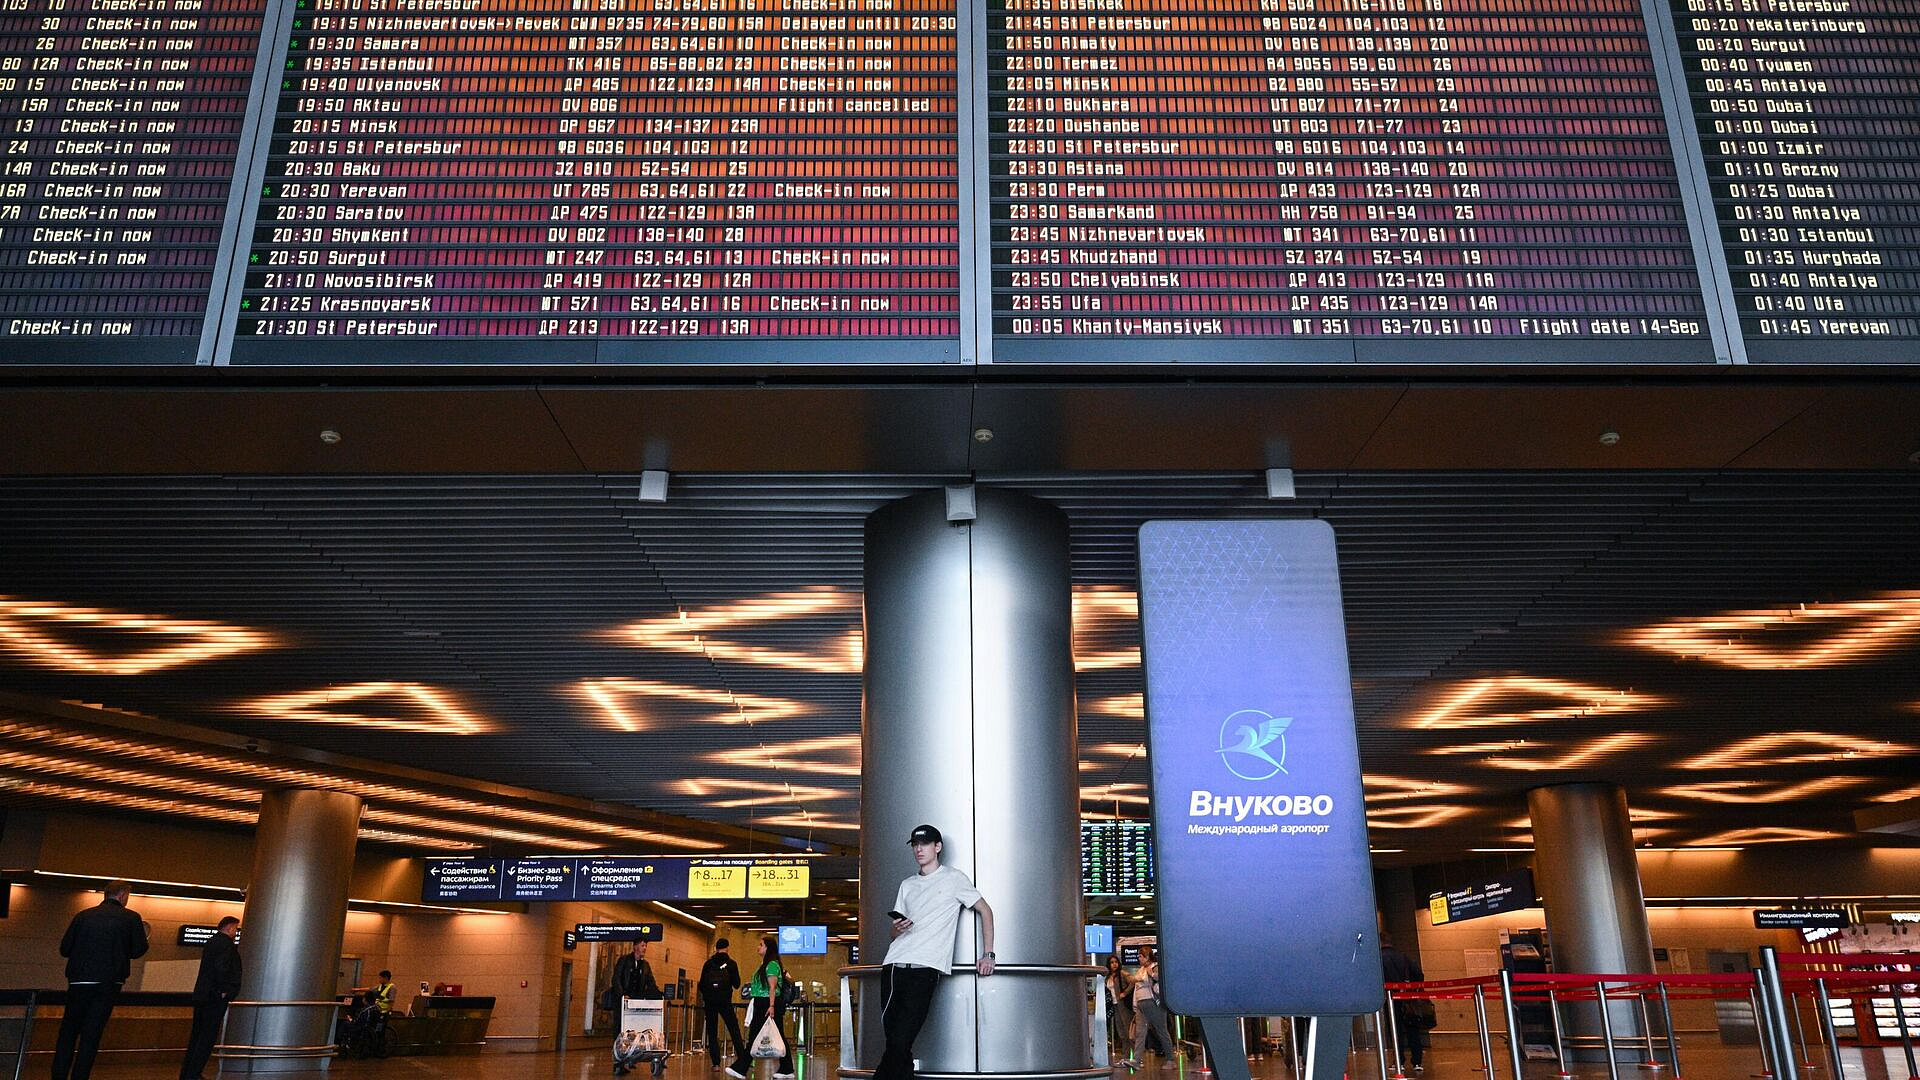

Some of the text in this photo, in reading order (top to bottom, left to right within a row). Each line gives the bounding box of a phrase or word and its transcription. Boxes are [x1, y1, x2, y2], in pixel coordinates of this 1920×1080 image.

[32, 57, 60, 71] 12A
[76, 57, 153, 71] Check-in
[161, 60, 189, 71] now
[306, 56, 892, 72] 19:35 Istanbul TK 416 85-88,82 23 Check-in now
[1006, 56, 1452, 72] 22:00 Termez A4 9055 59,60 26
[1700, 58, 1813, 73] 00:40 Tyumen
[21, 98, 180, 112] 15A Check-in now
[298, 98, 345, 112] 19:50
[353, 98, 401, 112] Aktau
[589, 98, 618, 112] 806
[778, 98, 833, 113] Flight
[845, 98, 930, 112] cancelled
[1007, 97, 1458, 112] 22:10 Bukhara UT 807 71-77 24
[1710, 99, 1813, 113] 00:50 Dubai
[8, 140, 171, 154] 24 Check-in now
[288, 140, 338, 154] 20:15
[346, 140, 364, 154] St
[374, 140, 462, 154] Petersbur
[585, 140, 625, 154] 6036
[645, 140, 710, 156] 104,103
[731, 140, 748, 154] 12
[1008, 139, 1056, 154] 22:30
[1065, 139, 1083, 154] St
[1093, 139, 1179, 154] Petersbur
[1302, 140, 1342, 154] 6016
[1361, 140, 1426, 156] 104,103
[1446, 140, 1465, 155] 14
[1719, 140, 1824, 155] 01:00 Izmir
[44, 183, 124, 198] Check-in
[132, 186, 162, 198] now
[280, 183, 891, 199] 20:30 Yerevan UT 785 63,64,61 22 Check-in now
[1009, 182, 1058, 197] 23:30
[1067, 182, 1105, 197] Perm
[1308, 183, 1336, 198] 433
[1366, 183, 1433, 198] 123-129
[1453, 183, 1481, 198] 12A
[1729, 183, 1835, 198] 01:25 Dubai
[33, 227, 152, 242] Check-in now
[272, 228, 323, 243] 20:30
[331, 227, 409, 244] Shymkent
[577, 227, 606, 242] 802
[638, 227, 704, 242] 138-140
[724, 227, 744, 242] 28
[1010, 226, 1059, 241] 23:45
[1069, 226, 1205, 242] Nizhnevartovsk
[1311, 227, 1339, 242] 341
[1370, 227, 1446, 244] 63-70,61
[1459, 227, 1475, 242] 11
[1739, 227, 1874, 243] 01:30 Istanbul
[264, 273, 315, 288] 21:10
[324, 273, 434, 288] Novosibirsk
[573, 273, 602, 288] 419
[635, 272, 702, 288] 122-129
[724, 272, 752, 288] 12A
[1011, 272, 1061, 287] 23:50
[1070, 272, 1180, 289] Chelyabinsk
[1317, 272, 1346, 287] 413
[1377, 272, 1445, 287] 123-129
[1466, 272, 1495, 287] 11A
[1749, 272, 1878, 290] 01:40 Antalya
[10, 319, 132, 335] Check-in now
[255, 320, 308, 335] 21:30
[316, 320, 335, 335] St
[346, 319, 438, 335] Petersbur
[568, 319, 598, 335] 213
[631, 319, 699, 335] 122-129
[721, 319, 749, 335] 13A
[1012, 318, 1063, 334] 00:05
[1072, 318, 1223, 336] Khanty-Mansiysk
[1322, 318, 1350, 334] 351
[1381, 318, 1459, 336] 63-70,61
[1473, 318, 1492, 334] 10
[1519, 318, 1579, 336] Flight
[1590, 319, 1631, 334] date
[1640, 319, 1700, 336] 14-Sep
[1759, 319, 1890, 335] 01:45 Yerevan
[1188, 790, 1334, 822] Внуково
[1187, 823, 1331, 837] Международный аэропорт
[441, 867, 488, 876] Содействие
[517, 866, 561, 874] Бизнес-зал
[591, 866, 644, 875] Оформление
[702, 869, 733, 880] 8...17
[762, 869, 800, 880] 18...31
[440, 875, 490, 884] пассажирам
[516, 875, 544, 884] Priority
[590, 875, 641, 883] спецсредств
[539, 883, 559, 891] lounge
